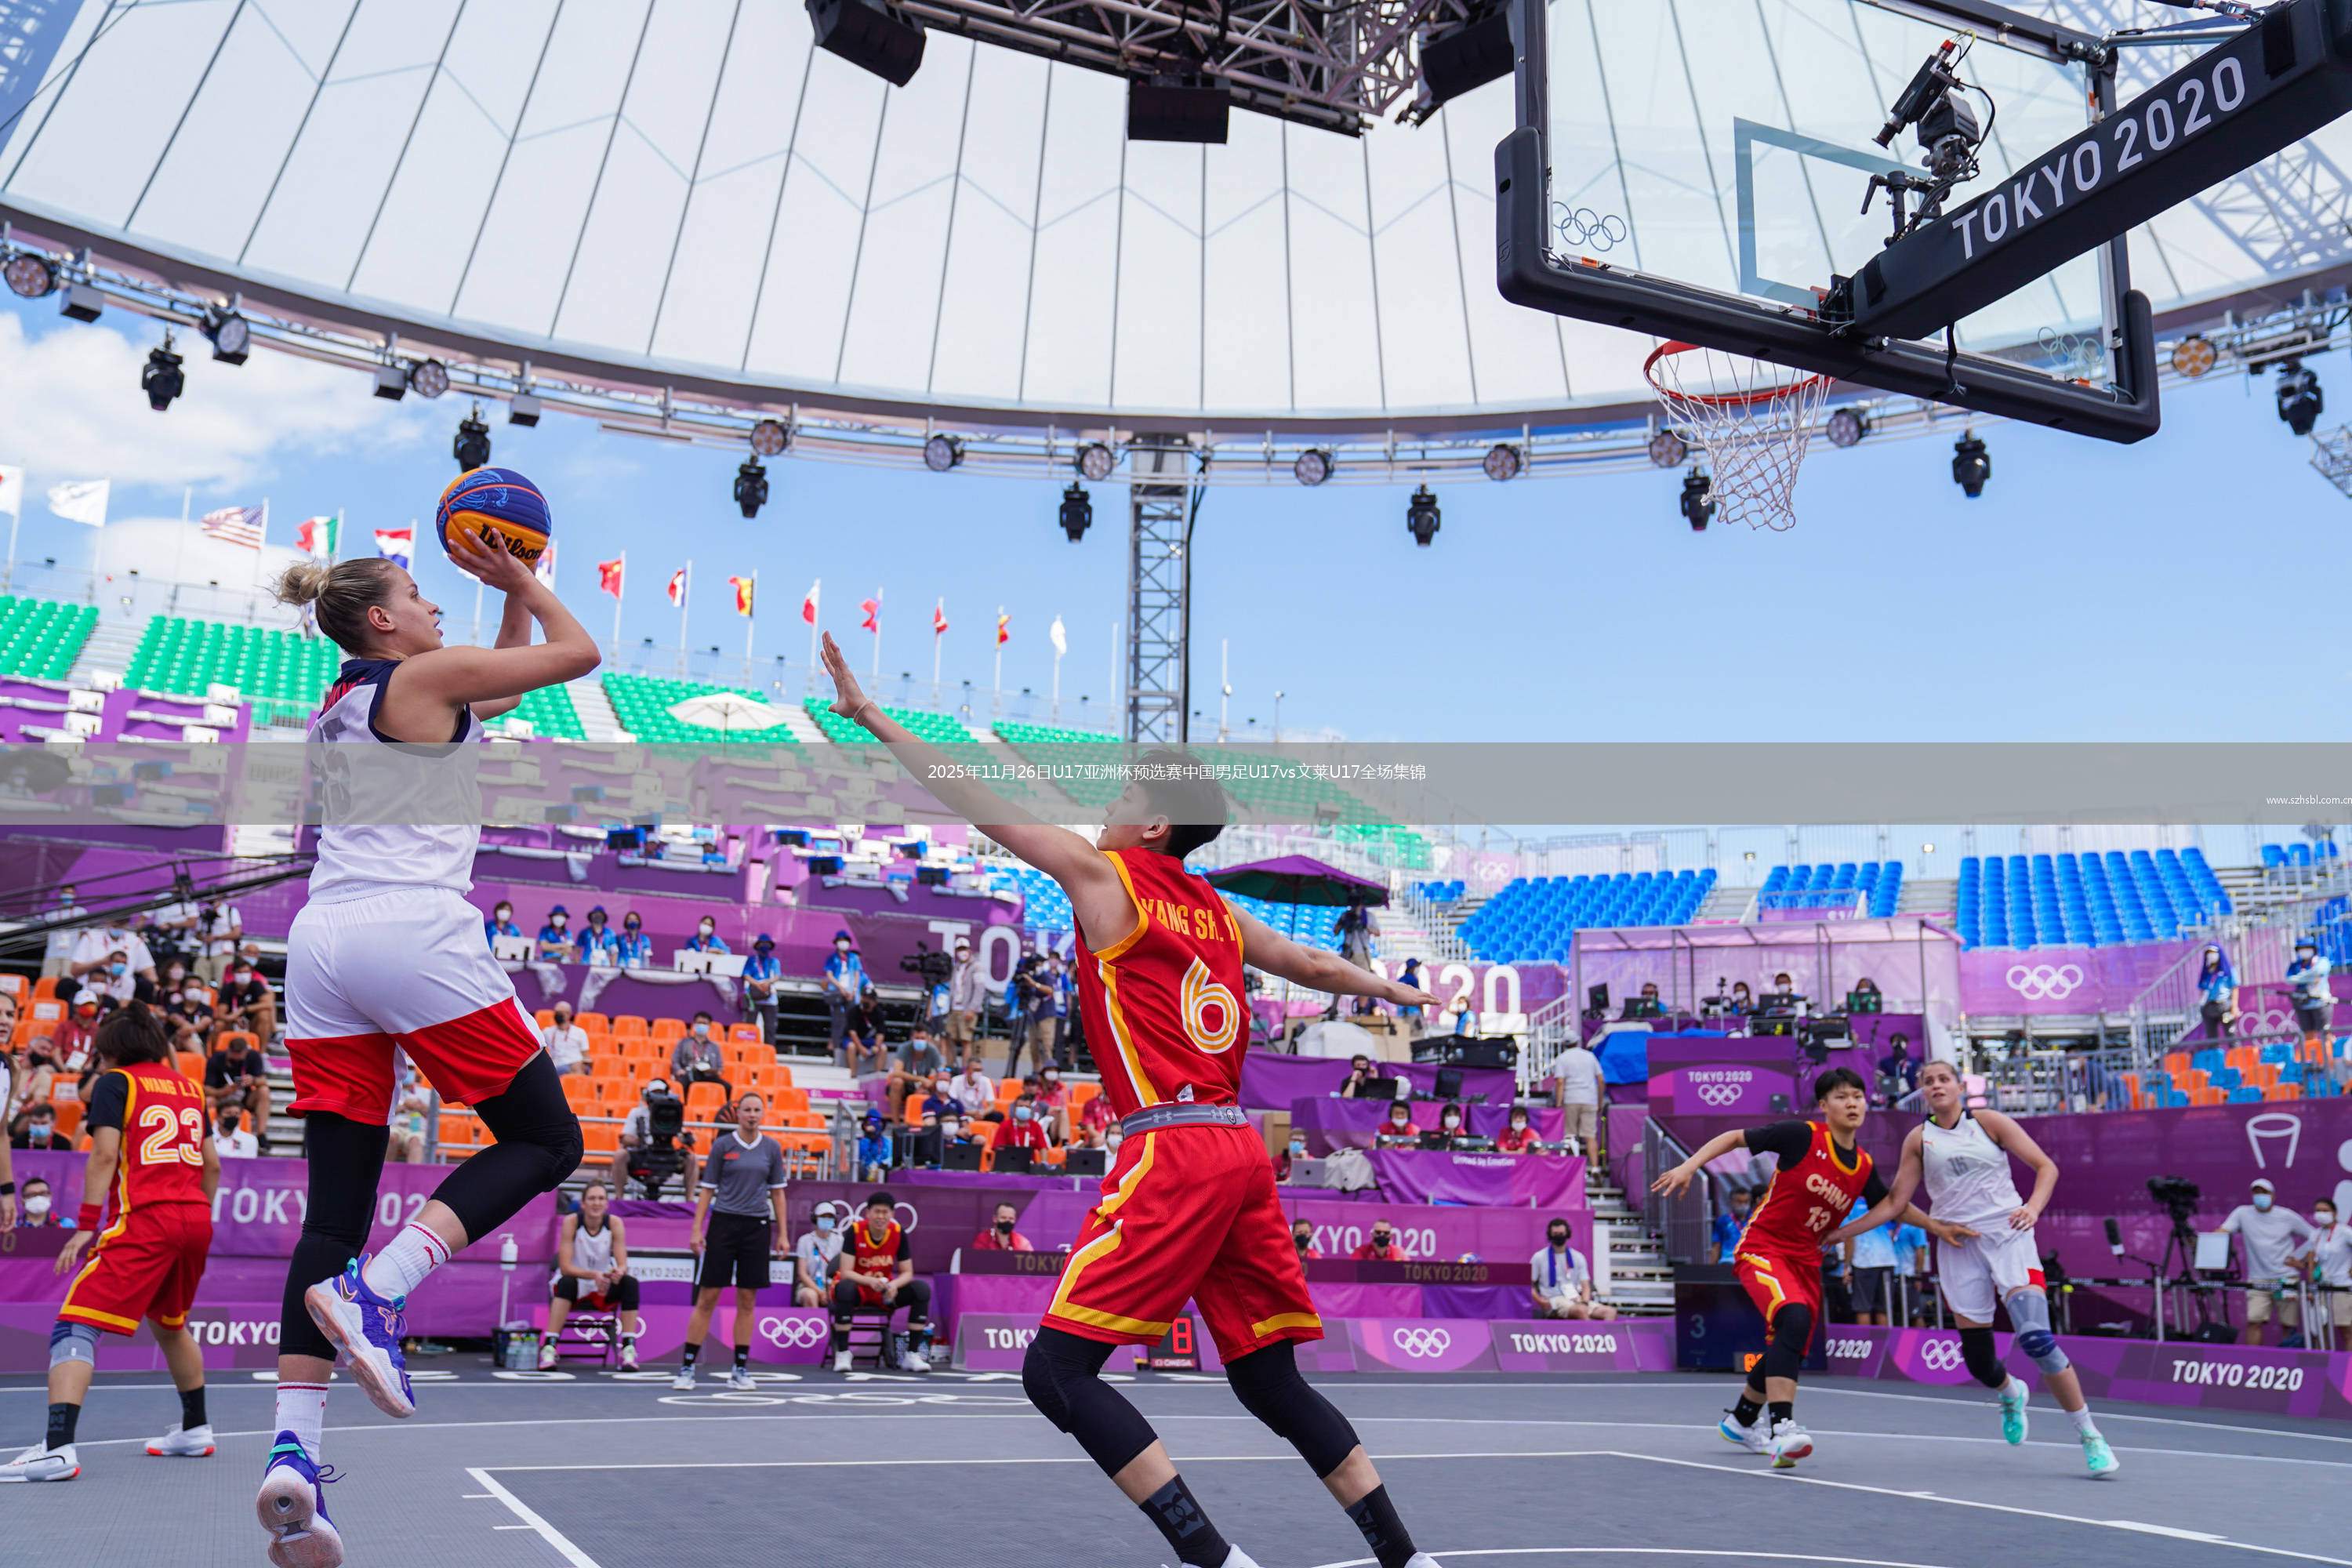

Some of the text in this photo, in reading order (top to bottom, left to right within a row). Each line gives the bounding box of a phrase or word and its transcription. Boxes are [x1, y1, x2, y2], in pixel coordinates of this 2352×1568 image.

[1952, 56, 2245, 260] TOKYO 2020
[1181, 955, 1240, 1054] 6
[1687, 1071, 1753, 1082] TOKYO 2020
[139, 1105, 204, 1166] 23
[1806, 1174, 1851, 1211] CHINA
[1805, 1207, 1831, 1232] 13
[771, 1269, 790, 1279] 020
[1404, 1265, 1488, 1281] TOKYO 2020
[1172, 1318, 1192, 1354] 8
[1690, 1314, 1706, 1338] 3
[1510, 1334, 1617, 1353] TOKYO 2020
[1835, 1339, 1873, 1359] 2020
[1164, 1359, 1192, 1367] OMEGA
[2172, 1359, 2304, 1392] TOKYO 2020
